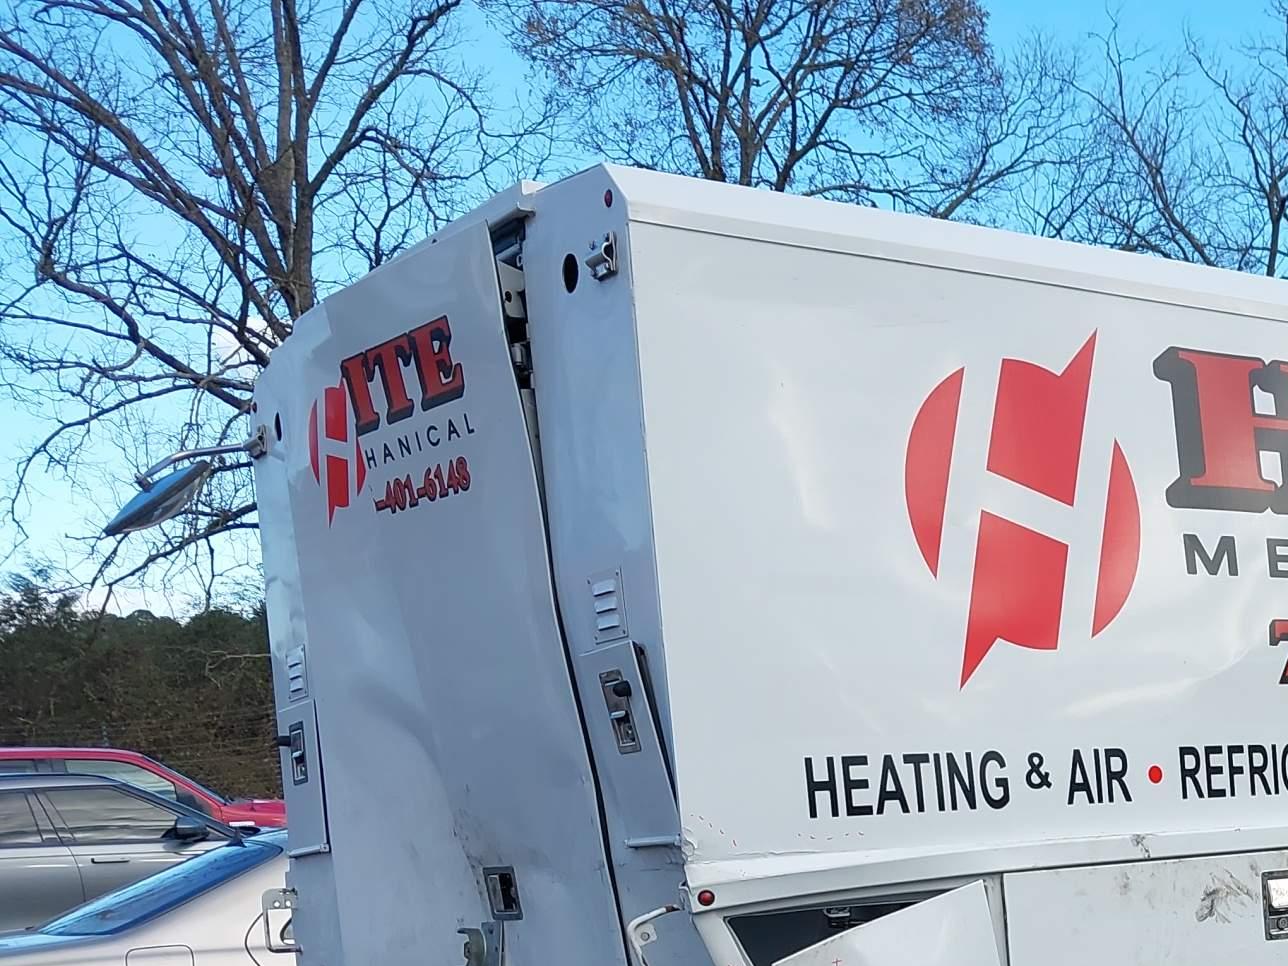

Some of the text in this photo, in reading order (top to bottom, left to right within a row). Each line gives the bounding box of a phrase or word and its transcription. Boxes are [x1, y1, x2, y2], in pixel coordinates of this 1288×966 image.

[340, 315, 466, 438] ITE
[364, 412, 476, 470] HANICAL
[374, 456, 472, 514] -401-6148
[804, 750, 1010, 819] HEATING
[1025, 752, 1053, 790] &
[1067, 747, 1133, 806] AIR
